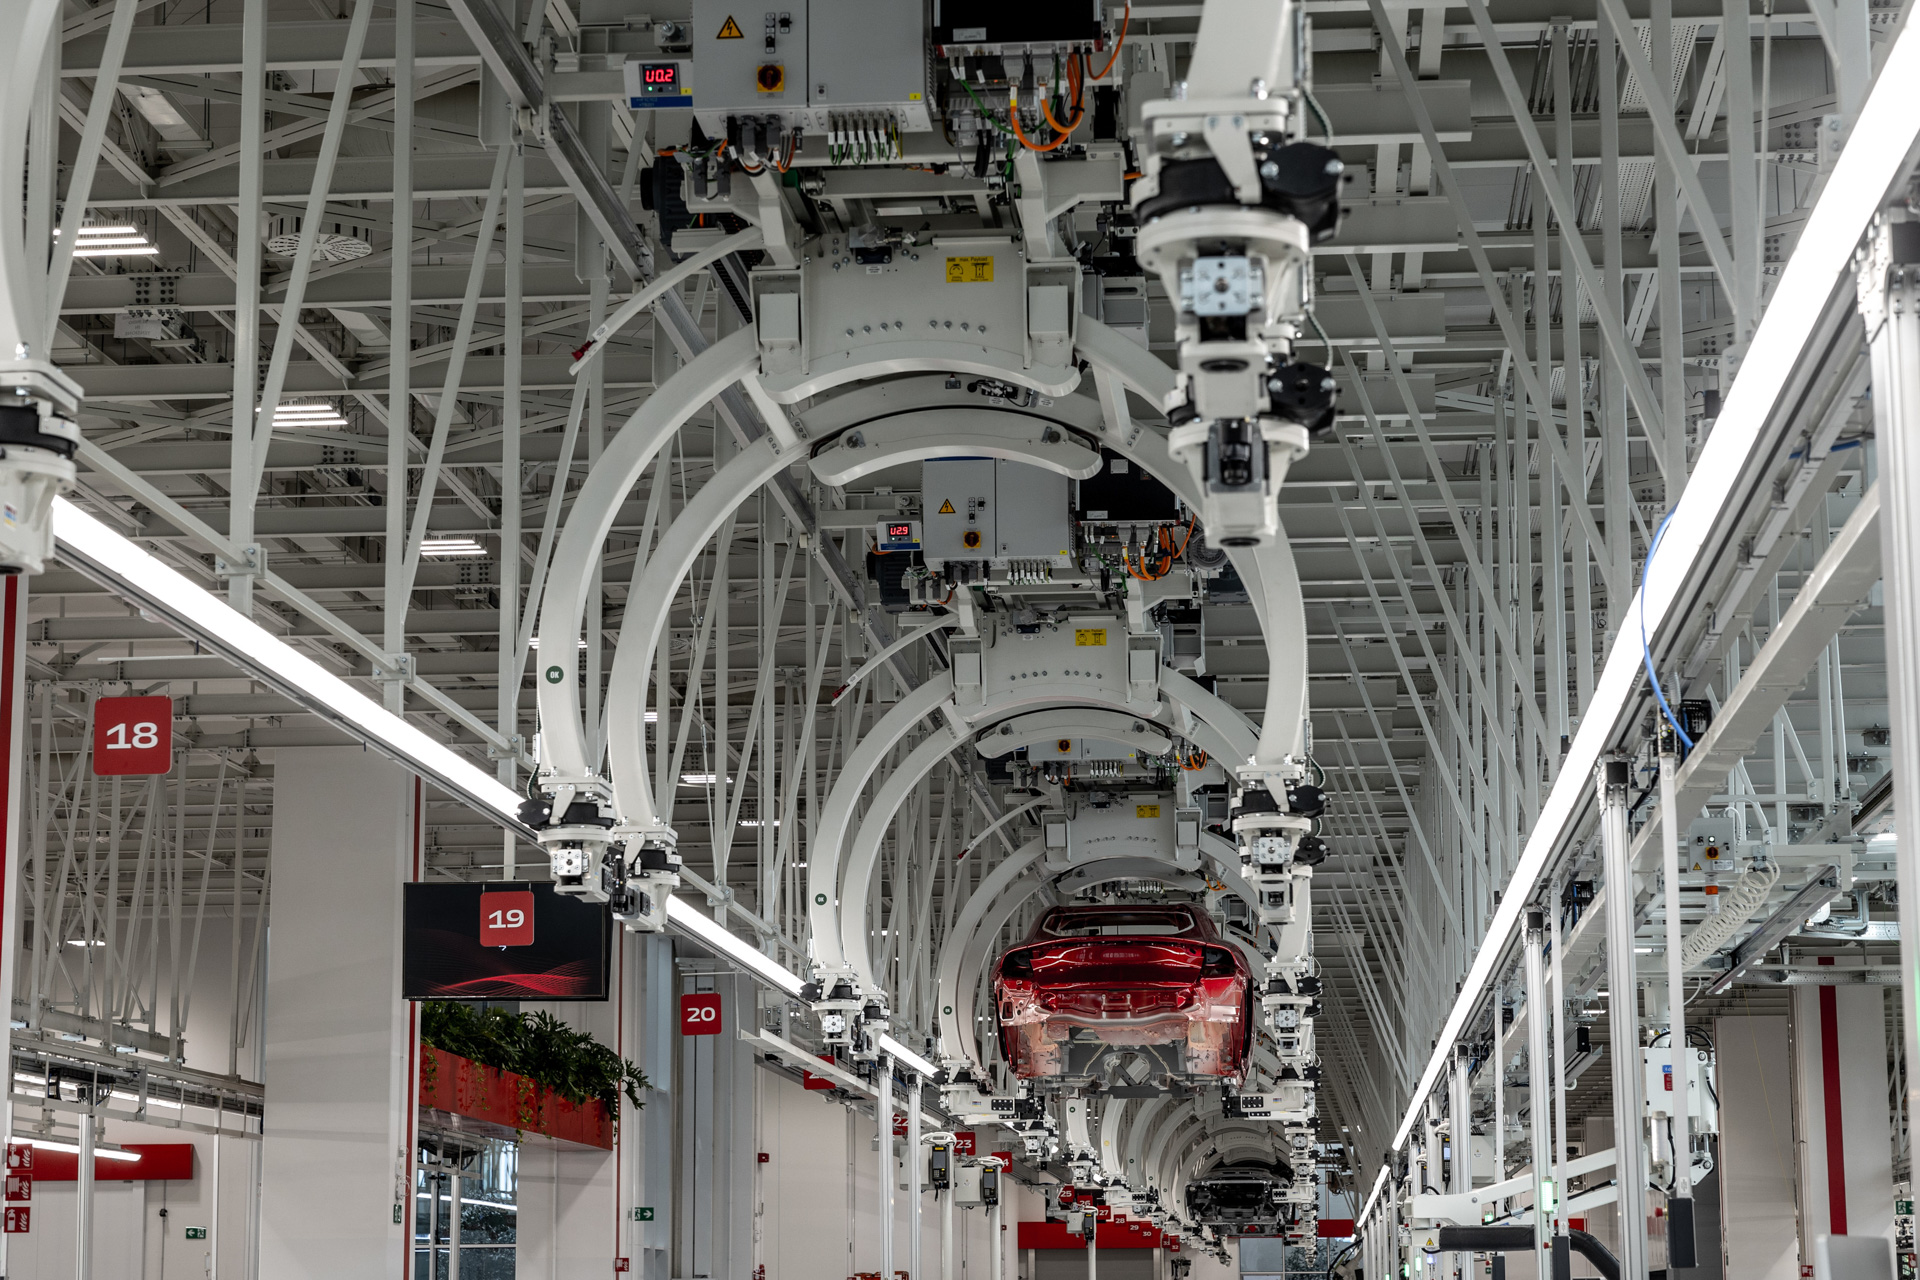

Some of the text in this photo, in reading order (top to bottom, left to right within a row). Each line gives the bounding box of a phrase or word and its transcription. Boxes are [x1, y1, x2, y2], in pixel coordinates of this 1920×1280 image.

[550, 671, 560, 679] OK
[106, 722, 159, 750] 18
[488, 909, 525, 929] 19
[687, 1006, 716, 1022] 20
[956, 1139, 972, 1149] 23
